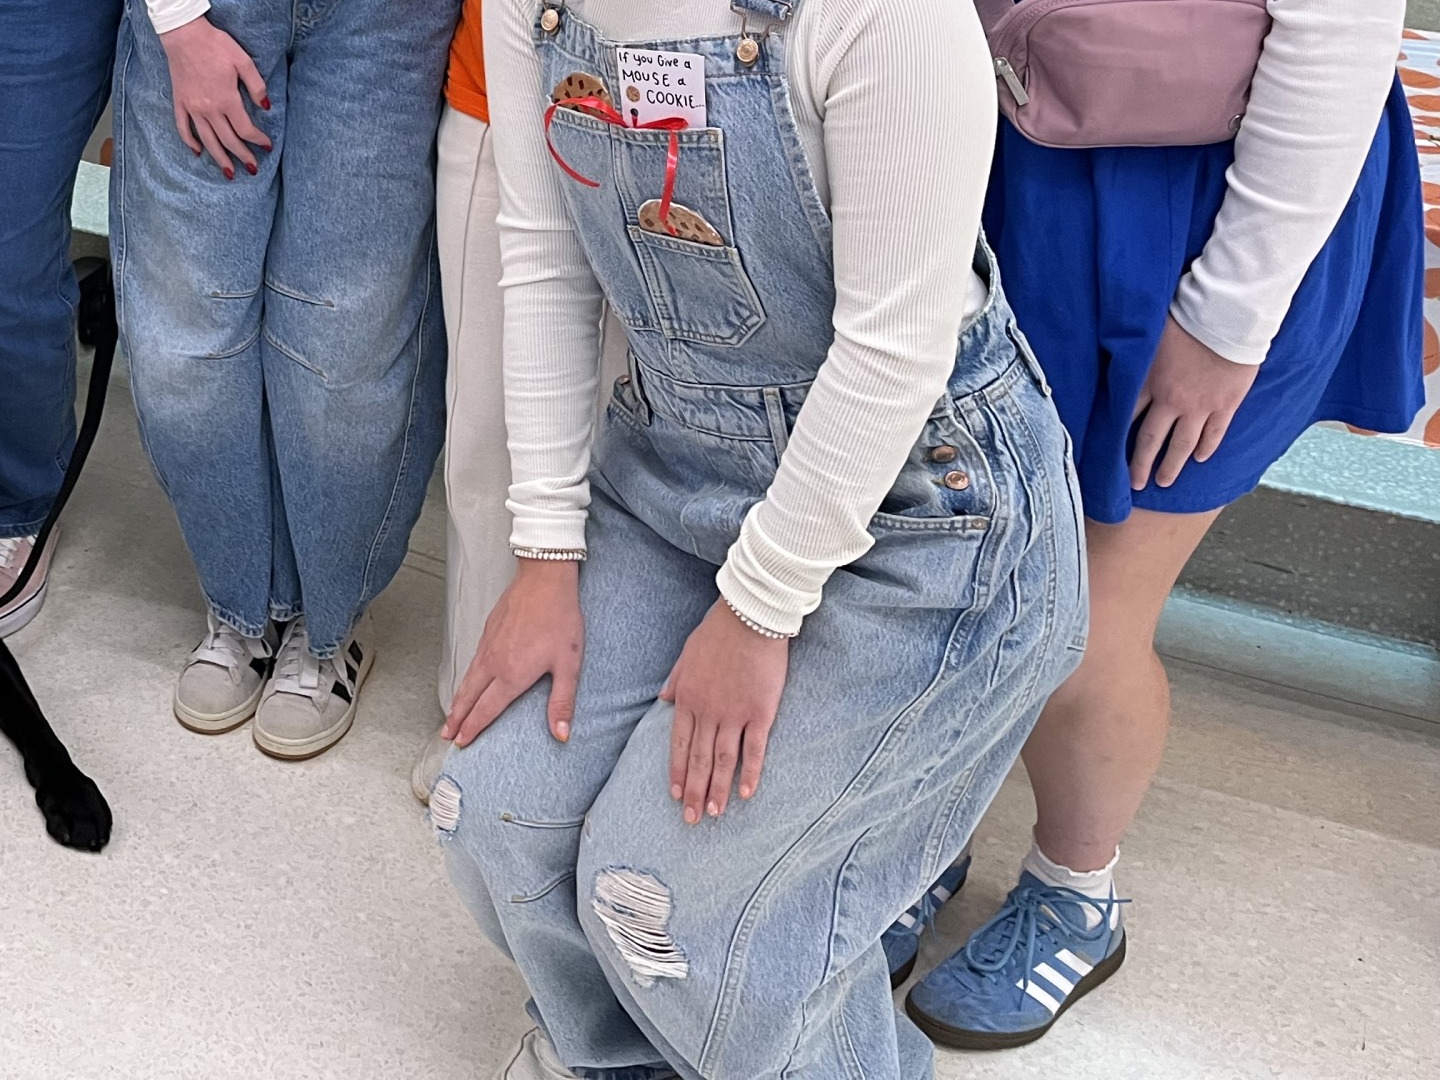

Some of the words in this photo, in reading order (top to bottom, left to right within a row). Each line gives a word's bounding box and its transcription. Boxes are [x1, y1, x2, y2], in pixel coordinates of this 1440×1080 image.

[619, 51, 629, 63] If
[633, 54, 653, 66] you
[657, 55, 678, 67] Give
[684, 60, 691, 69] a
[622, 69, 670, 87] MOUSE
[677, 78, 686, 86] a
